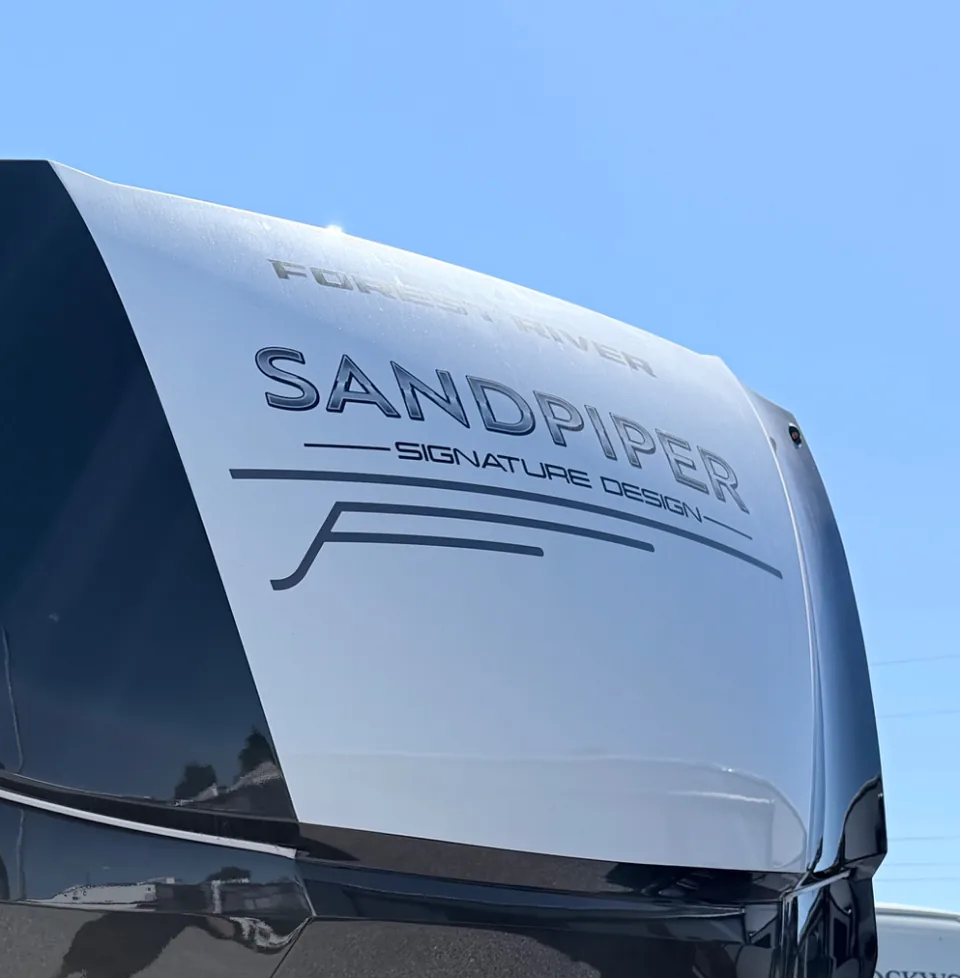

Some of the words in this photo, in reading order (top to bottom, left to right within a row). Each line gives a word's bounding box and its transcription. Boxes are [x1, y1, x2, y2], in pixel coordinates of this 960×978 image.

[512, 314, 658, 378] RIVER
[254, 346, 751, 514] SANDPIPER
[395, 441, 593, 489] SIGNATURE
[602, 474, 703, 523] DESIGN
